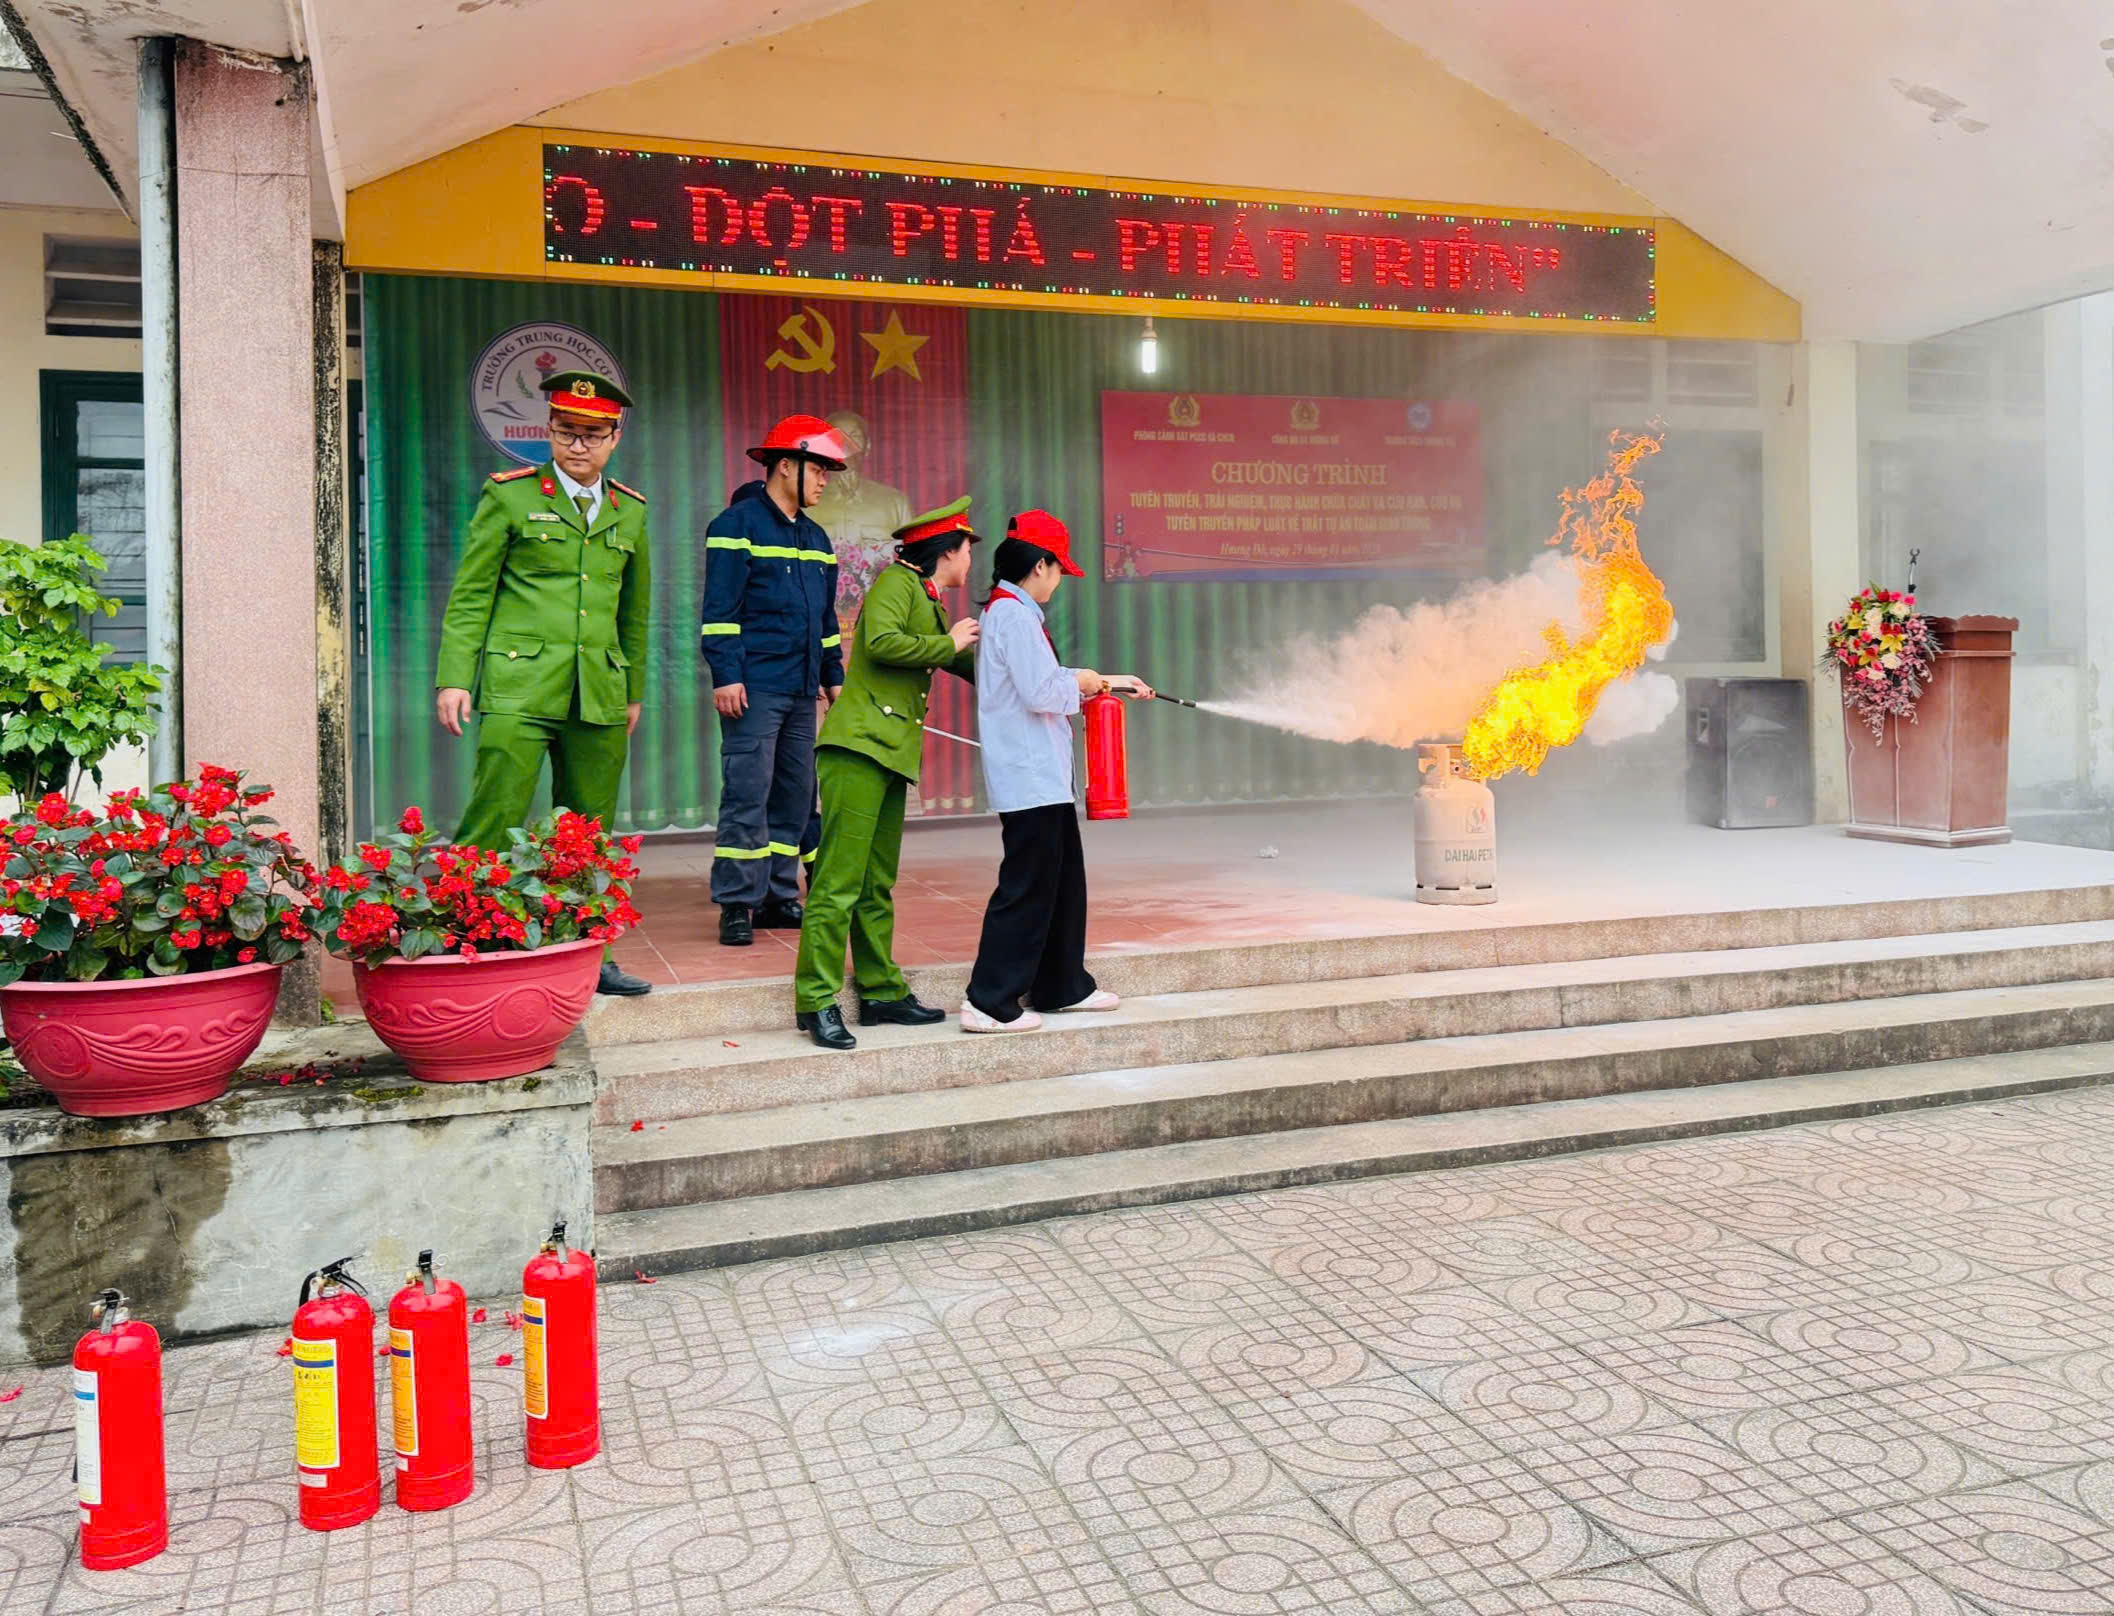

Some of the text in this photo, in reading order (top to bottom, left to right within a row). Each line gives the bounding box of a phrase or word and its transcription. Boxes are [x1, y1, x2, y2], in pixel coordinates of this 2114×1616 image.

[482, 343, 515, 392] TRƯỜNG
[515, 331, 563, 347] TRUNG
[566, 336, 597, 359] HỌC
[504, 425, 551, 439] HƯƠN
[1211, 458, 1388, 485] CHƯƠNG TRÌNH
[1130, 490, 1160, 508] TUYÊN
[1166, 513, 1197, 531] TUYÊN
